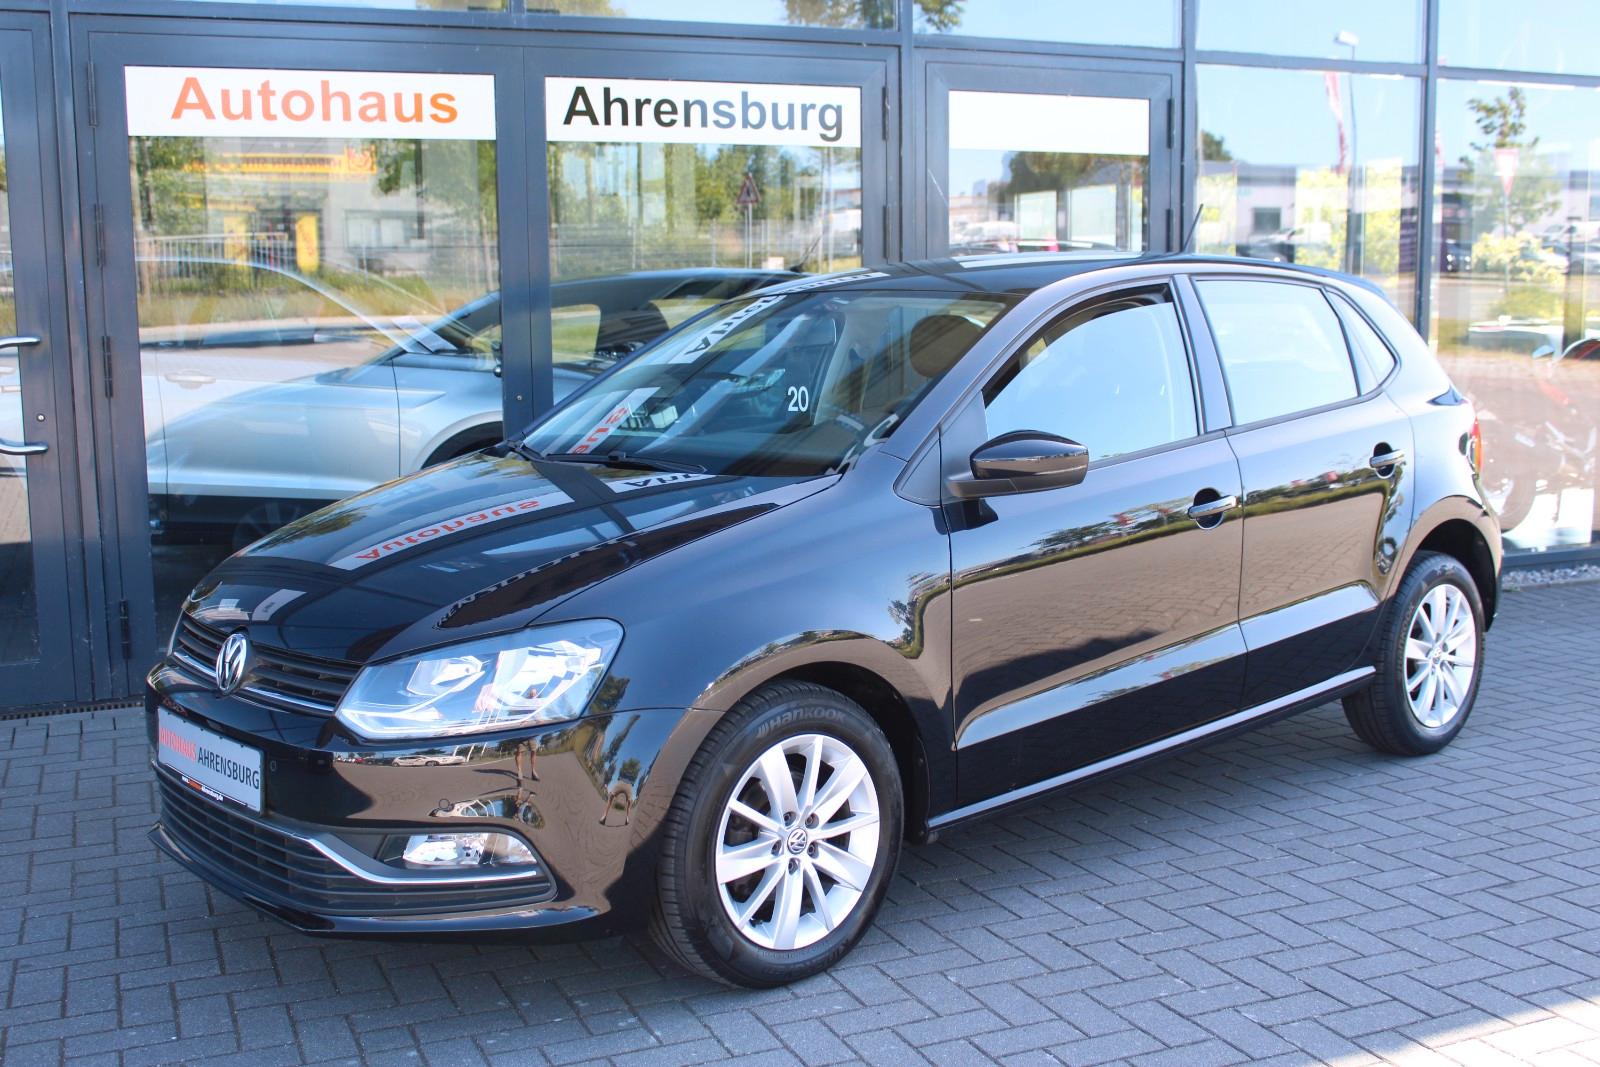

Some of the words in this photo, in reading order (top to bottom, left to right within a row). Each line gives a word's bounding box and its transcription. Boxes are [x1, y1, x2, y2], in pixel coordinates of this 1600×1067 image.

[171, 77, 458, 125] Autohaus
[563, 85, 843, 141] Ahrensburg
[787, 386, 809, 413] 20
[159, 727, 197, 762] AUTOHAUS
[198, 747, 260, 790] AHRENSBURG
